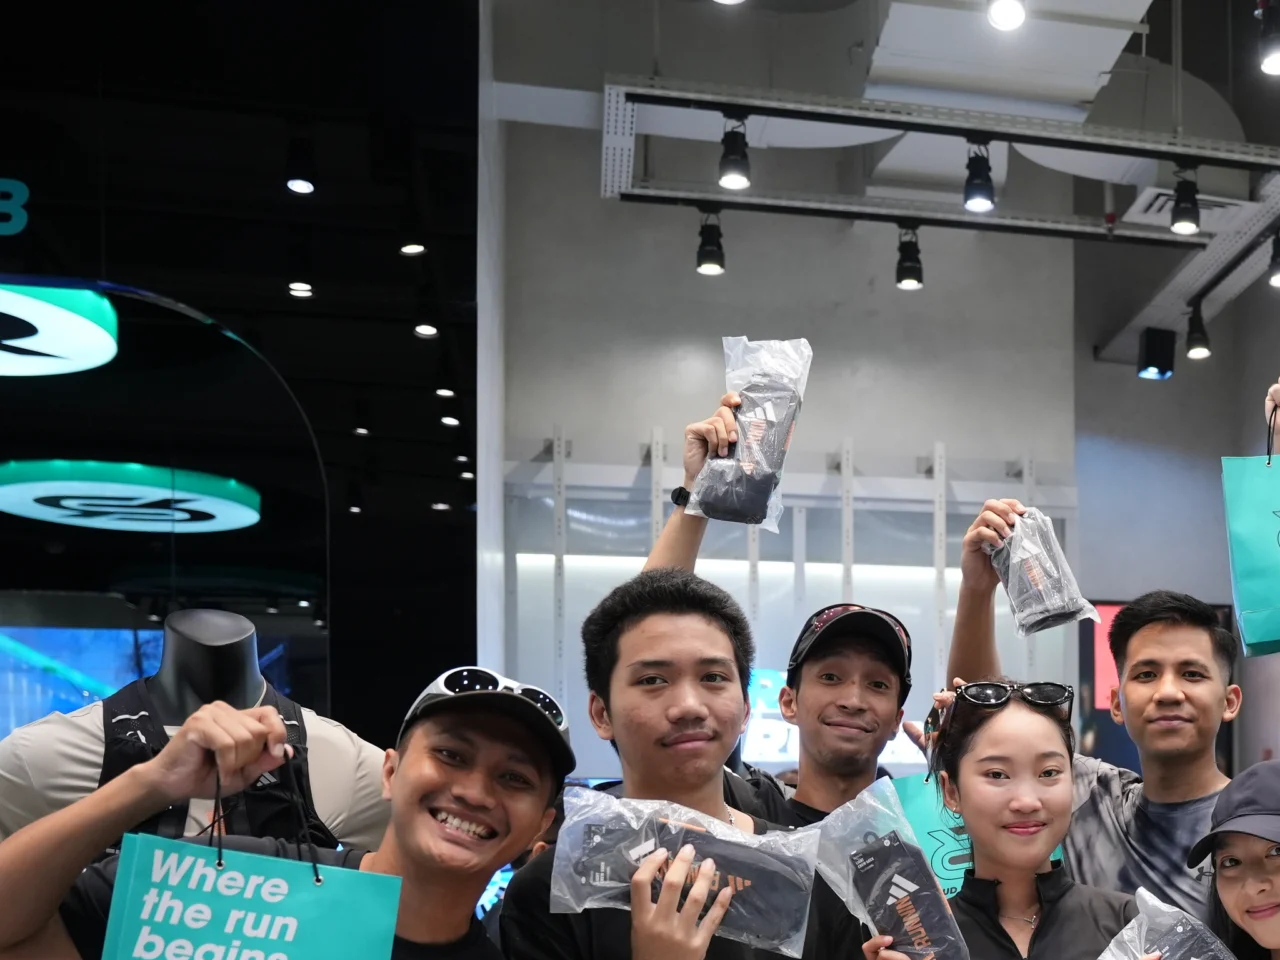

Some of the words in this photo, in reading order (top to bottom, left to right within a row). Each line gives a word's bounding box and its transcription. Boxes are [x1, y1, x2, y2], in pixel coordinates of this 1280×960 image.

[149, 848, 289, 903] Where
[139, 887, 213, 929] the
[223, 908, 299, 942] run
